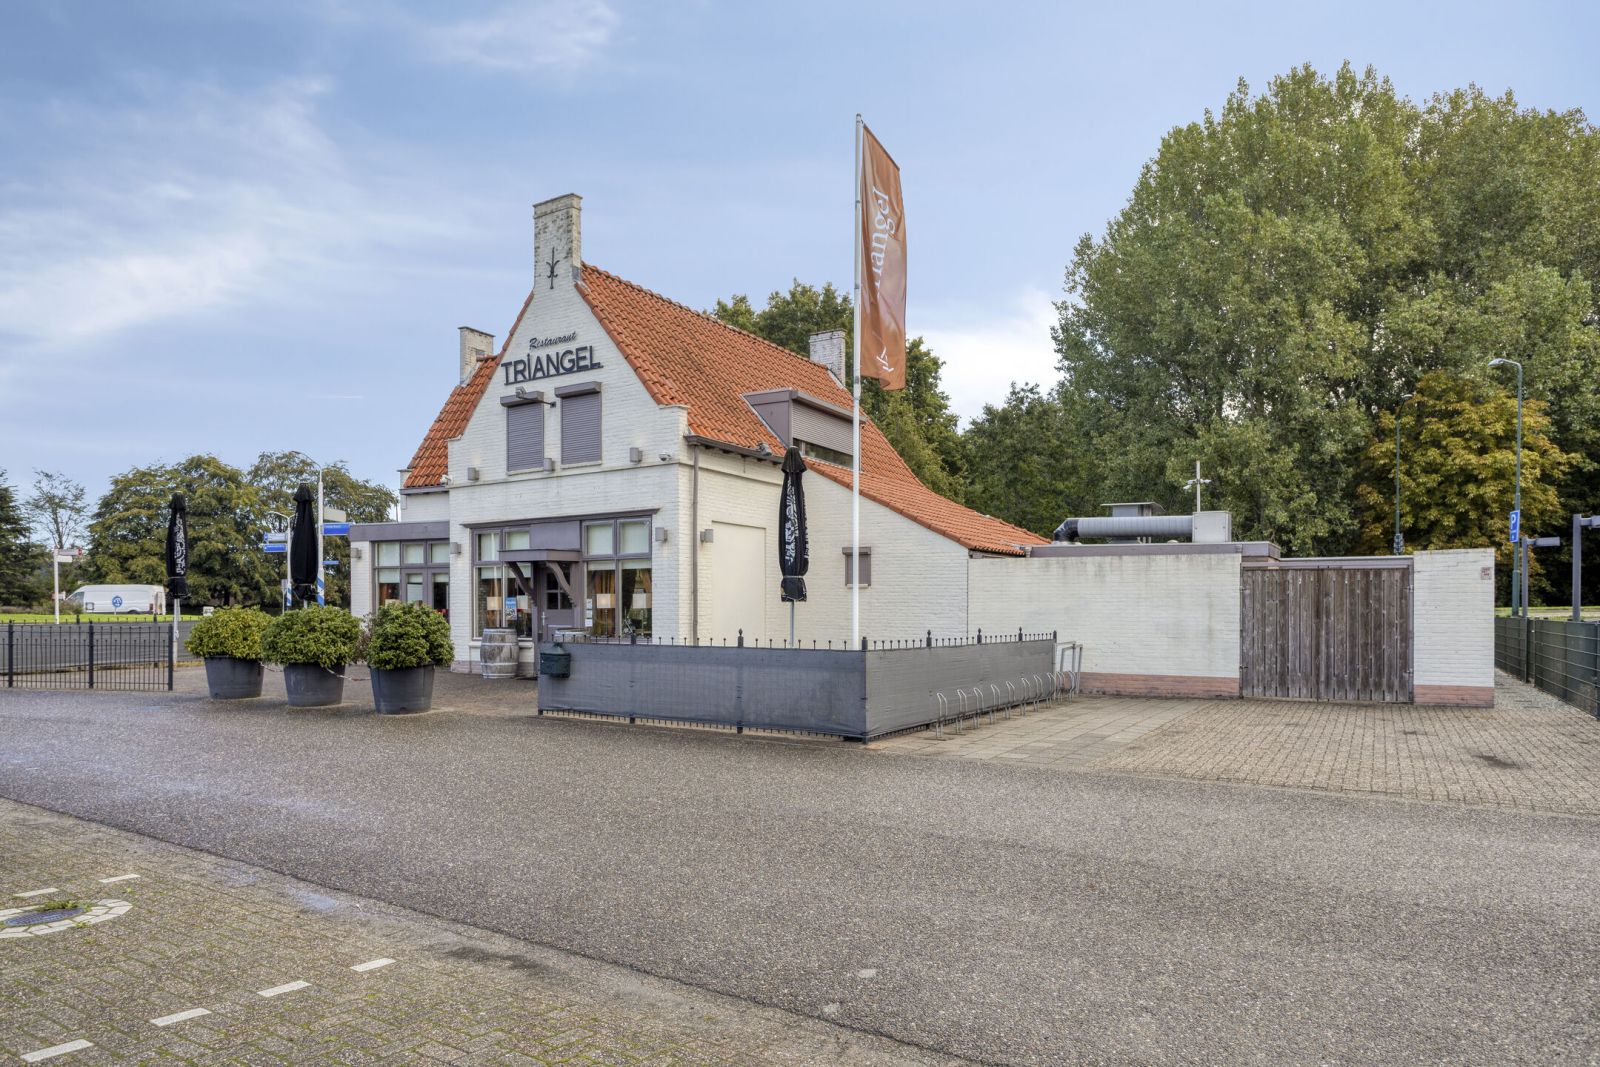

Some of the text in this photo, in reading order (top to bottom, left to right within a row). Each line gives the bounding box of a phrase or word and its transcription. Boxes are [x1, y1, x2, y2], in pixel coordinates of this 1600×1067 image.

[529, 331, 577, 350] Restaurant
[501, 345, 602, 385] TRIANGEL
[1511, 514, 1516, 529] P
